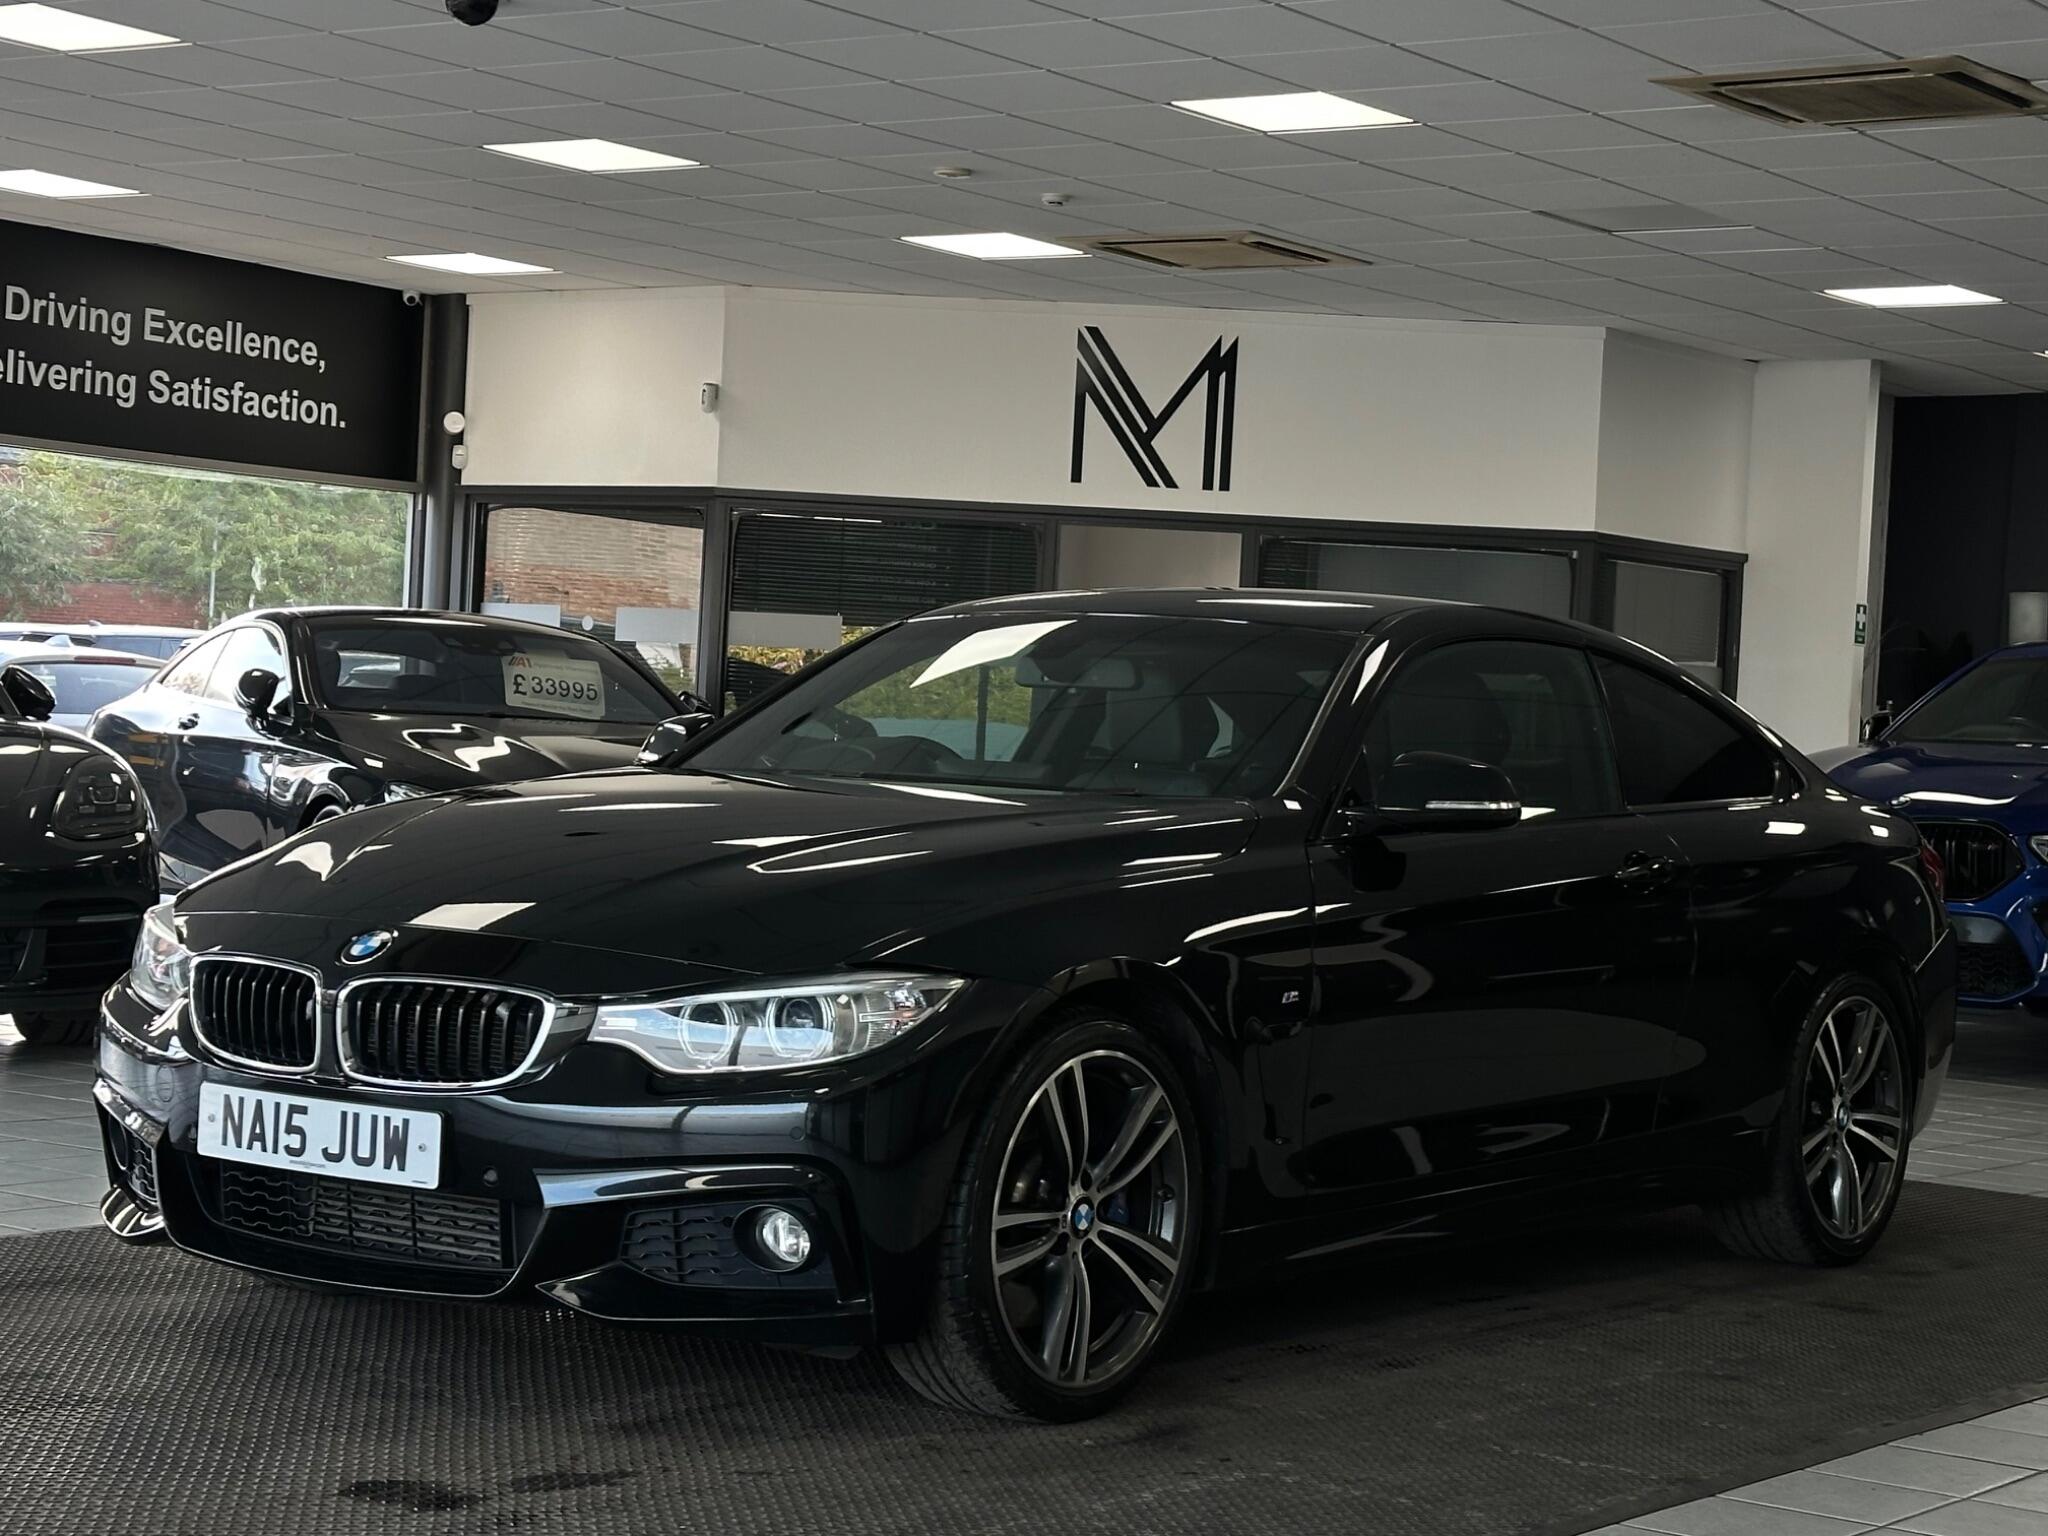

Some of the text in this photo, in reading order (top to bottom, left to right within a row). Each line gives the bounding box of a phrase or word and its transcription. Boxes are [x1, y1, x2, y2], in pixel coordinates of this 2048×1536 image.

[4, 285, 326, 374] Driving Excellence,
[0, 348, 347, 429] livering Satisfaction.
[512, 673, 598, 701] £33995
[221, 1093, 410, 1172] NA15 JUW
